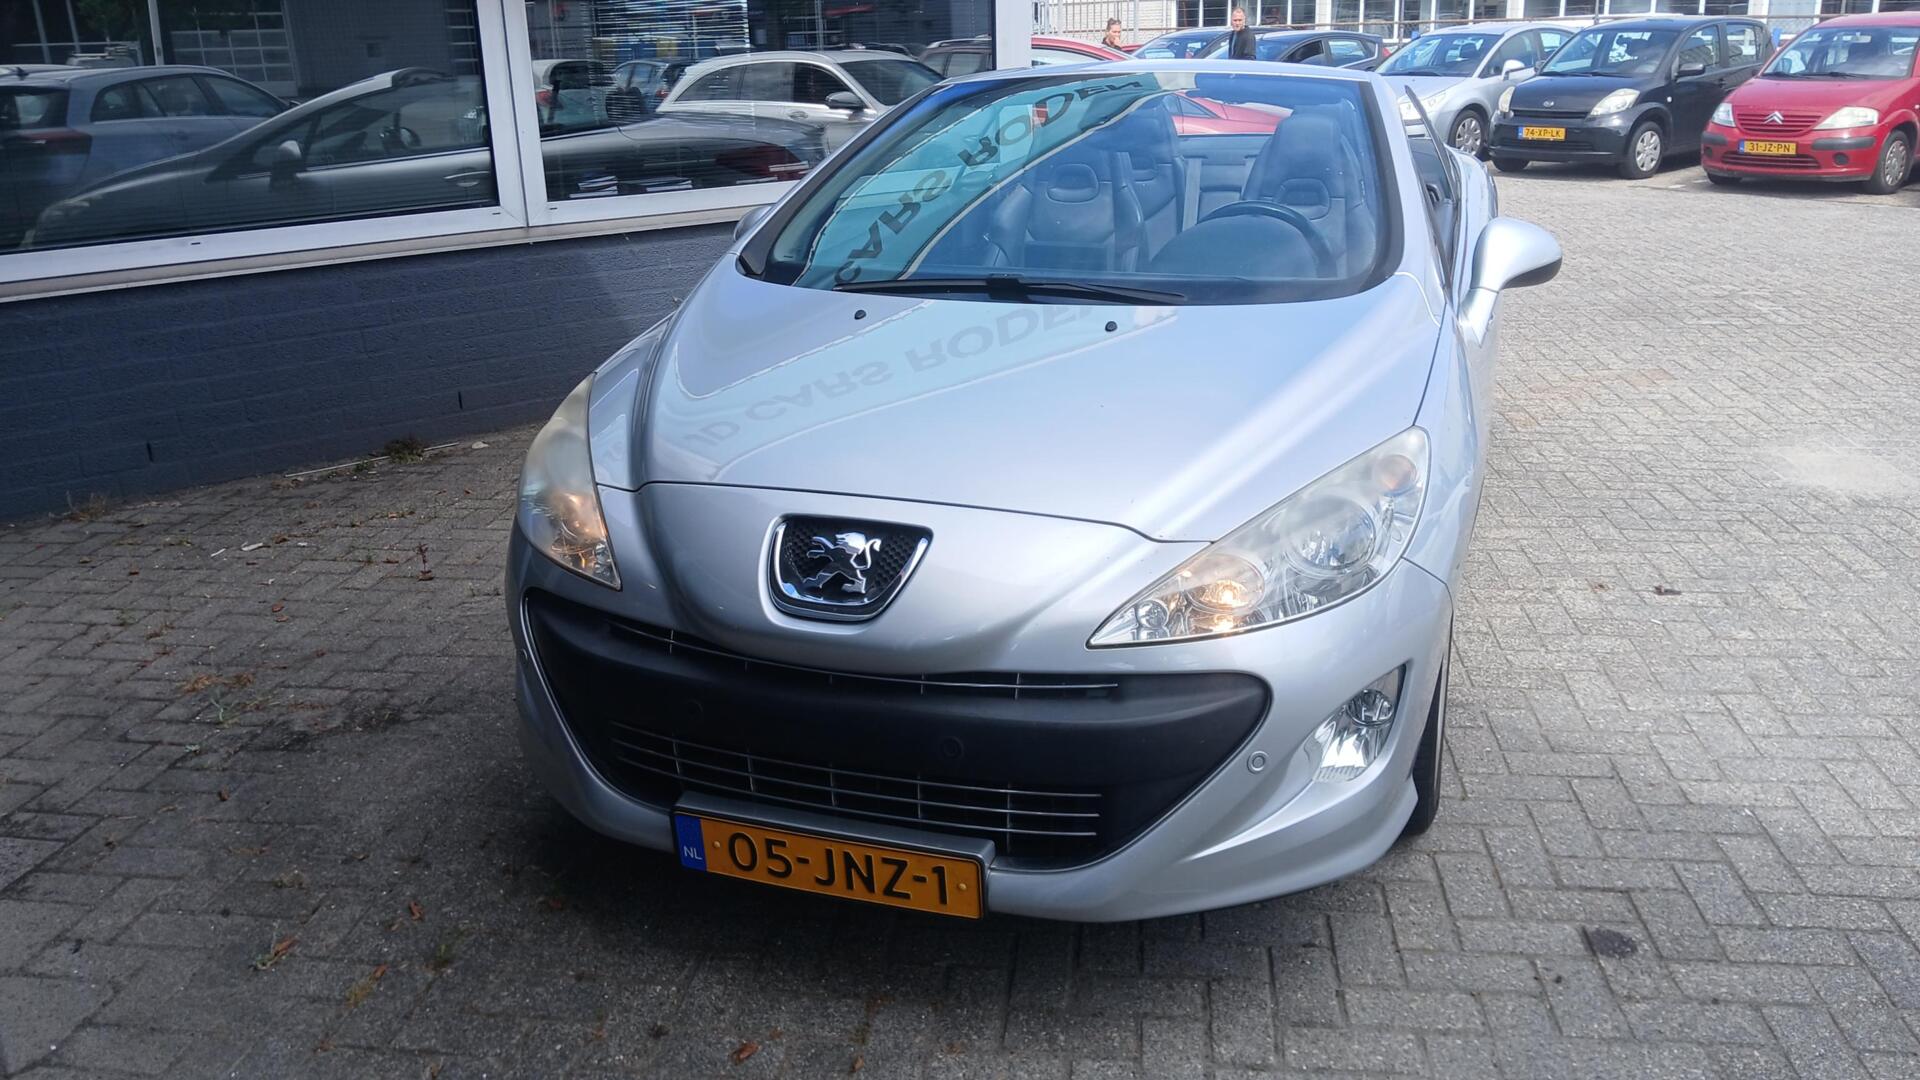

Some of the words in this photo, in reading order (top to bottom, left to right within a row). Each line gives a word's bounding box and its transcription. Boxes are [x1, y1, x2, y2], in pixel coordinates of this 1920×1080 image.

[1524, 127, 1562, 138] 74-XP-LK
[1748, 142, 1791, 153] 31-JZ-PN
[683, 845, 704, 861] NL
[727, 831, 949, 906] 05-JNZ-1
